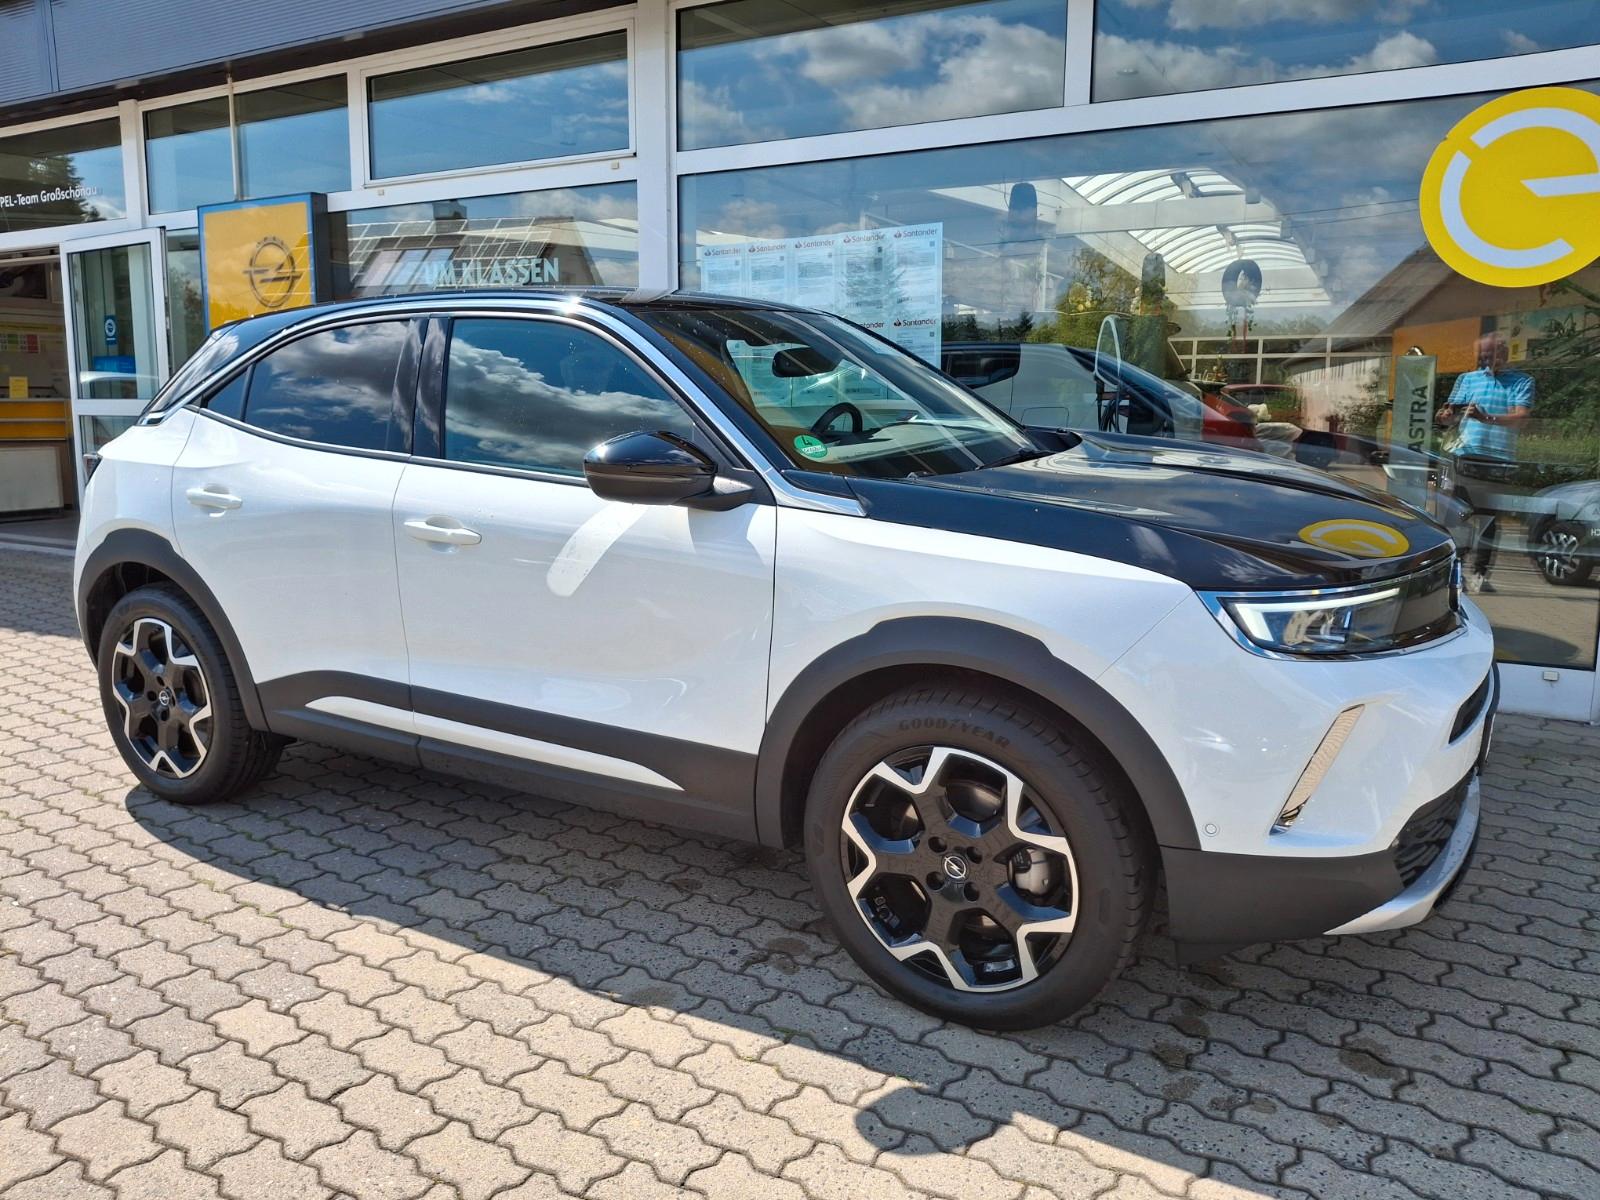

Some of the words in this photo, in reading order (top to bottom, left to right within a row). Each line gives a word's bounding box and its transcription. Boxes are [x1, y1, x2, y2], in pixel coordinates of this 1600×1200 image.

[0, 194, 38, 208] PEL-Team
[40, 185, 97, 202] Großschönau
[852, 233, 885, 243] Santander
[903, 228, 938, 238] Santander
[756, 243, 786, 253] Santander
[803, 238, 835, 249] Santander
[902, 318, 937, 327] Santander
[1408, 384, 1428, 454] ASTRA
